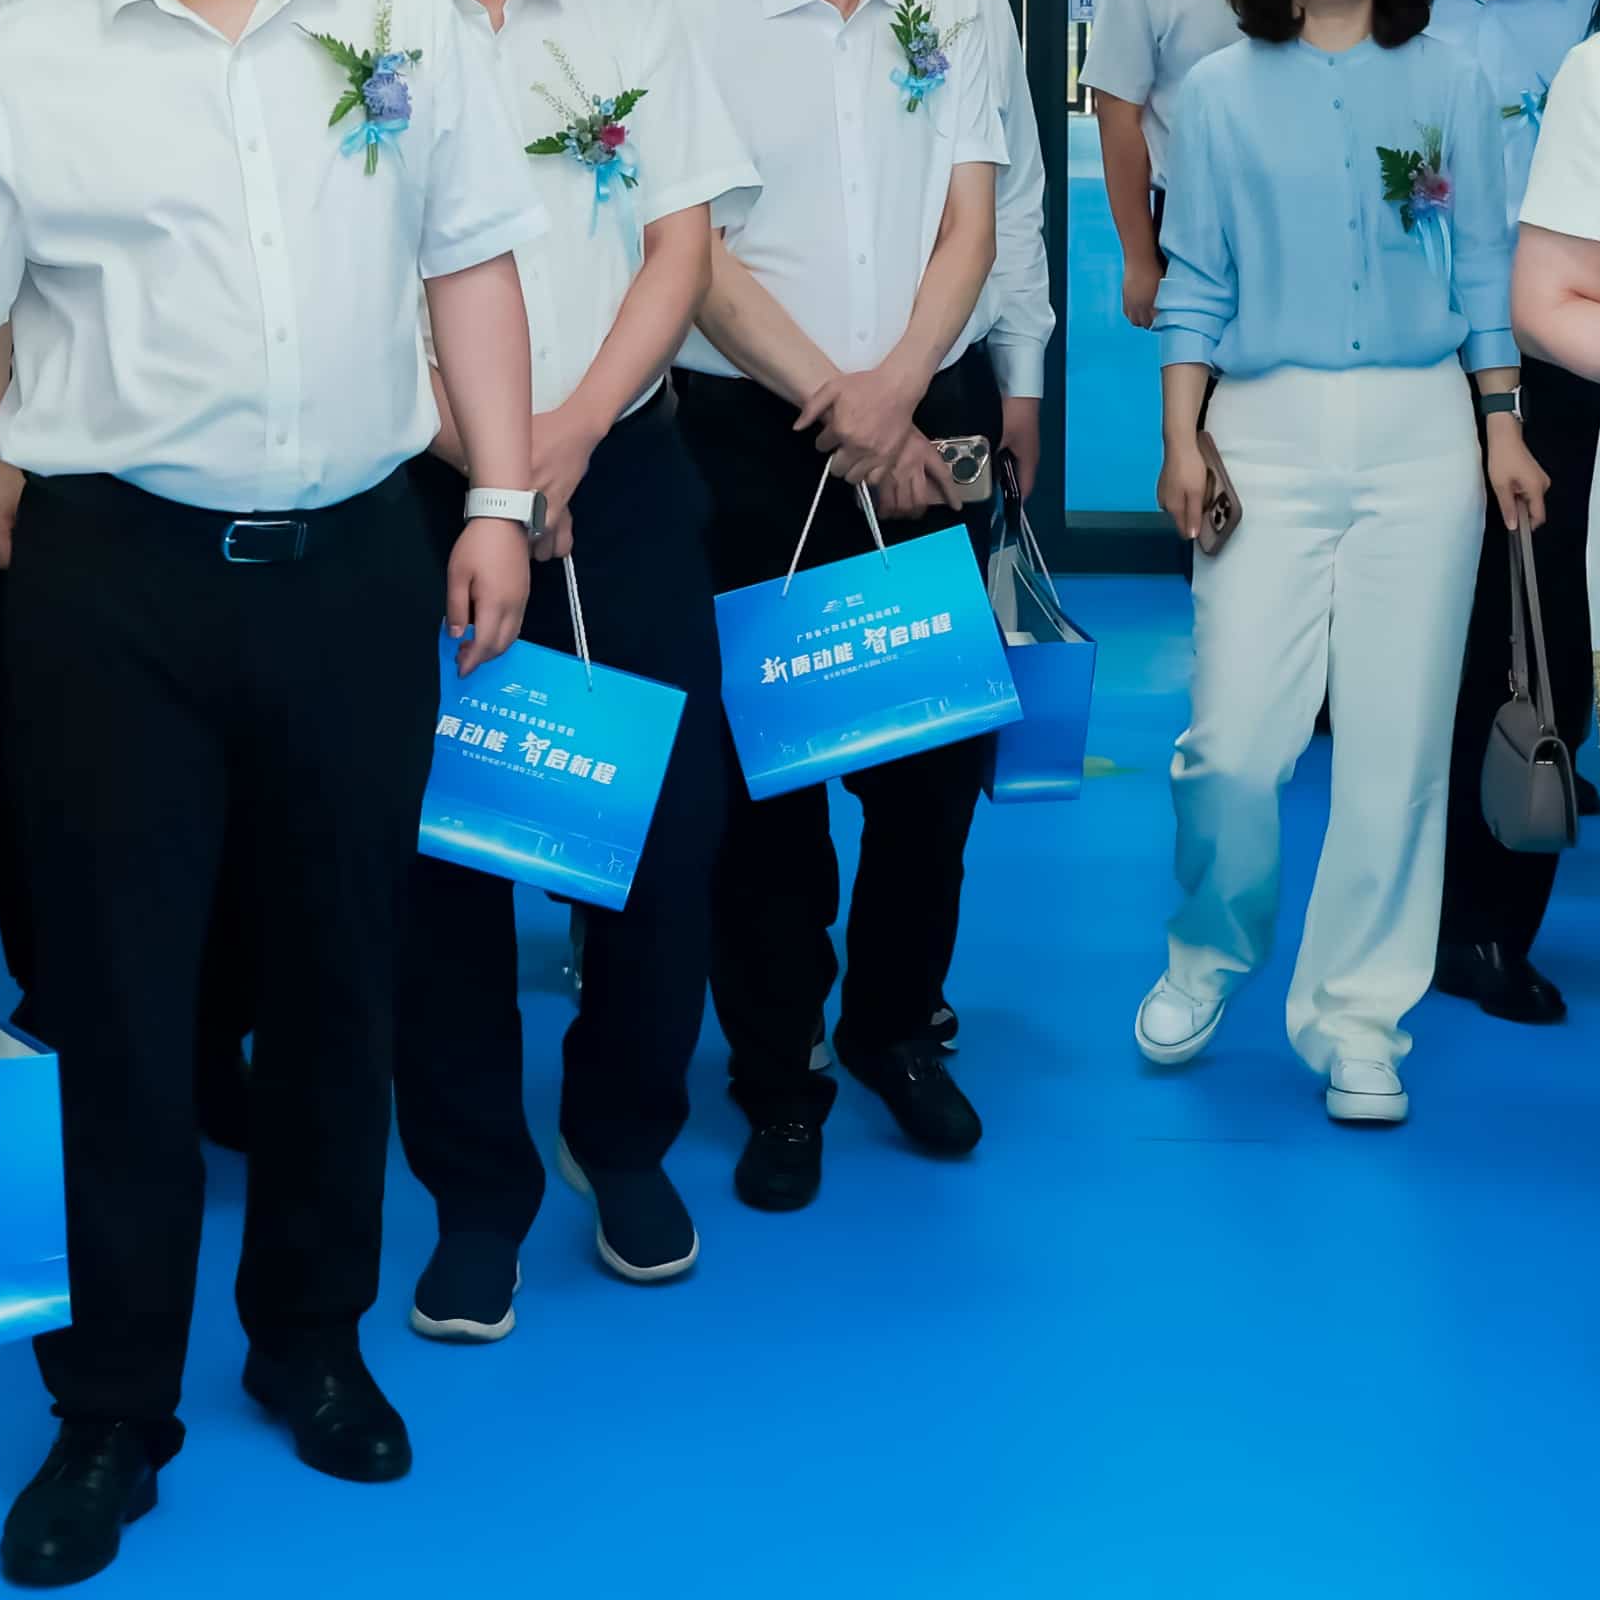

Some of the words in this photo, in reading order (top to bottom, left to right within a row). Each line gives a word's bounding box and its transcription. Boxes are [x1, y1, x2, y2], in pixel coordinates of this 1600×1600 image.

[760, 641, 854, 685] 新质动能
[862, 612, 953, 655] 智启新程
[518, 730, 618, 785] 智启新程
